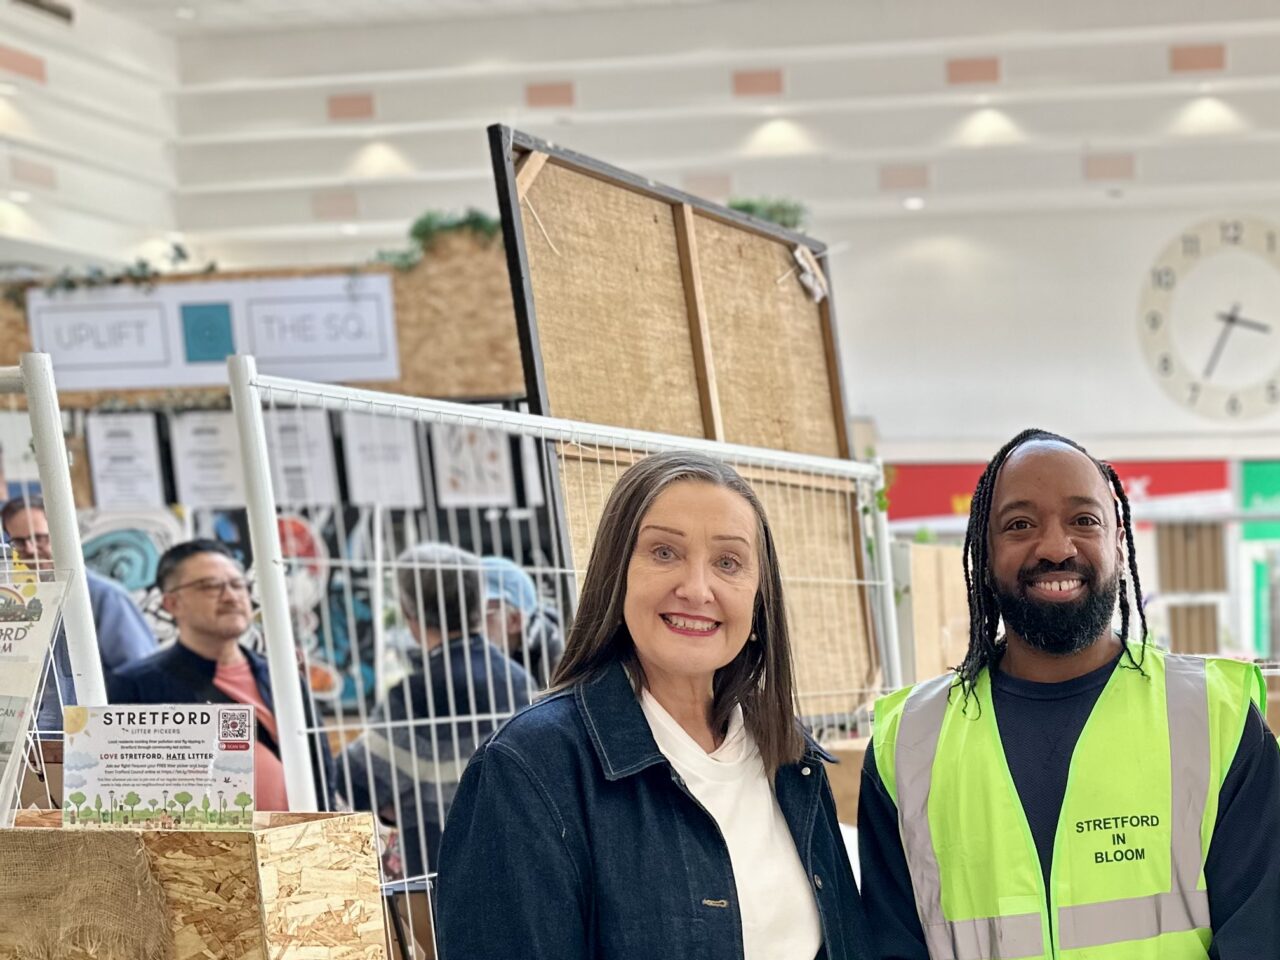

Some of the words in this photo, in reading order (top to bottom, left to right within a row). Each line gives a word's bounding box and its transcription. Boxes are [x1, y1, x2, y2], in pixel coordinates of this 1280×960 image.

[1218, 219, 1244, 246] 12
[1266, 230, 1276, 253] 1
[1181, 233, 1200, 257] 11
[1151, 265, 1177, 292] 10
[53, 318, 149, 351] UPLIFT
[262, 313, 316, 342] THE
[103, 711, 211, 726] STRETFORD
[1075, 815, 1160, 833] STRETFORD
[1112, 833, 1126, 845] IN
[1094, 848, 1145, 864] BLOOM
